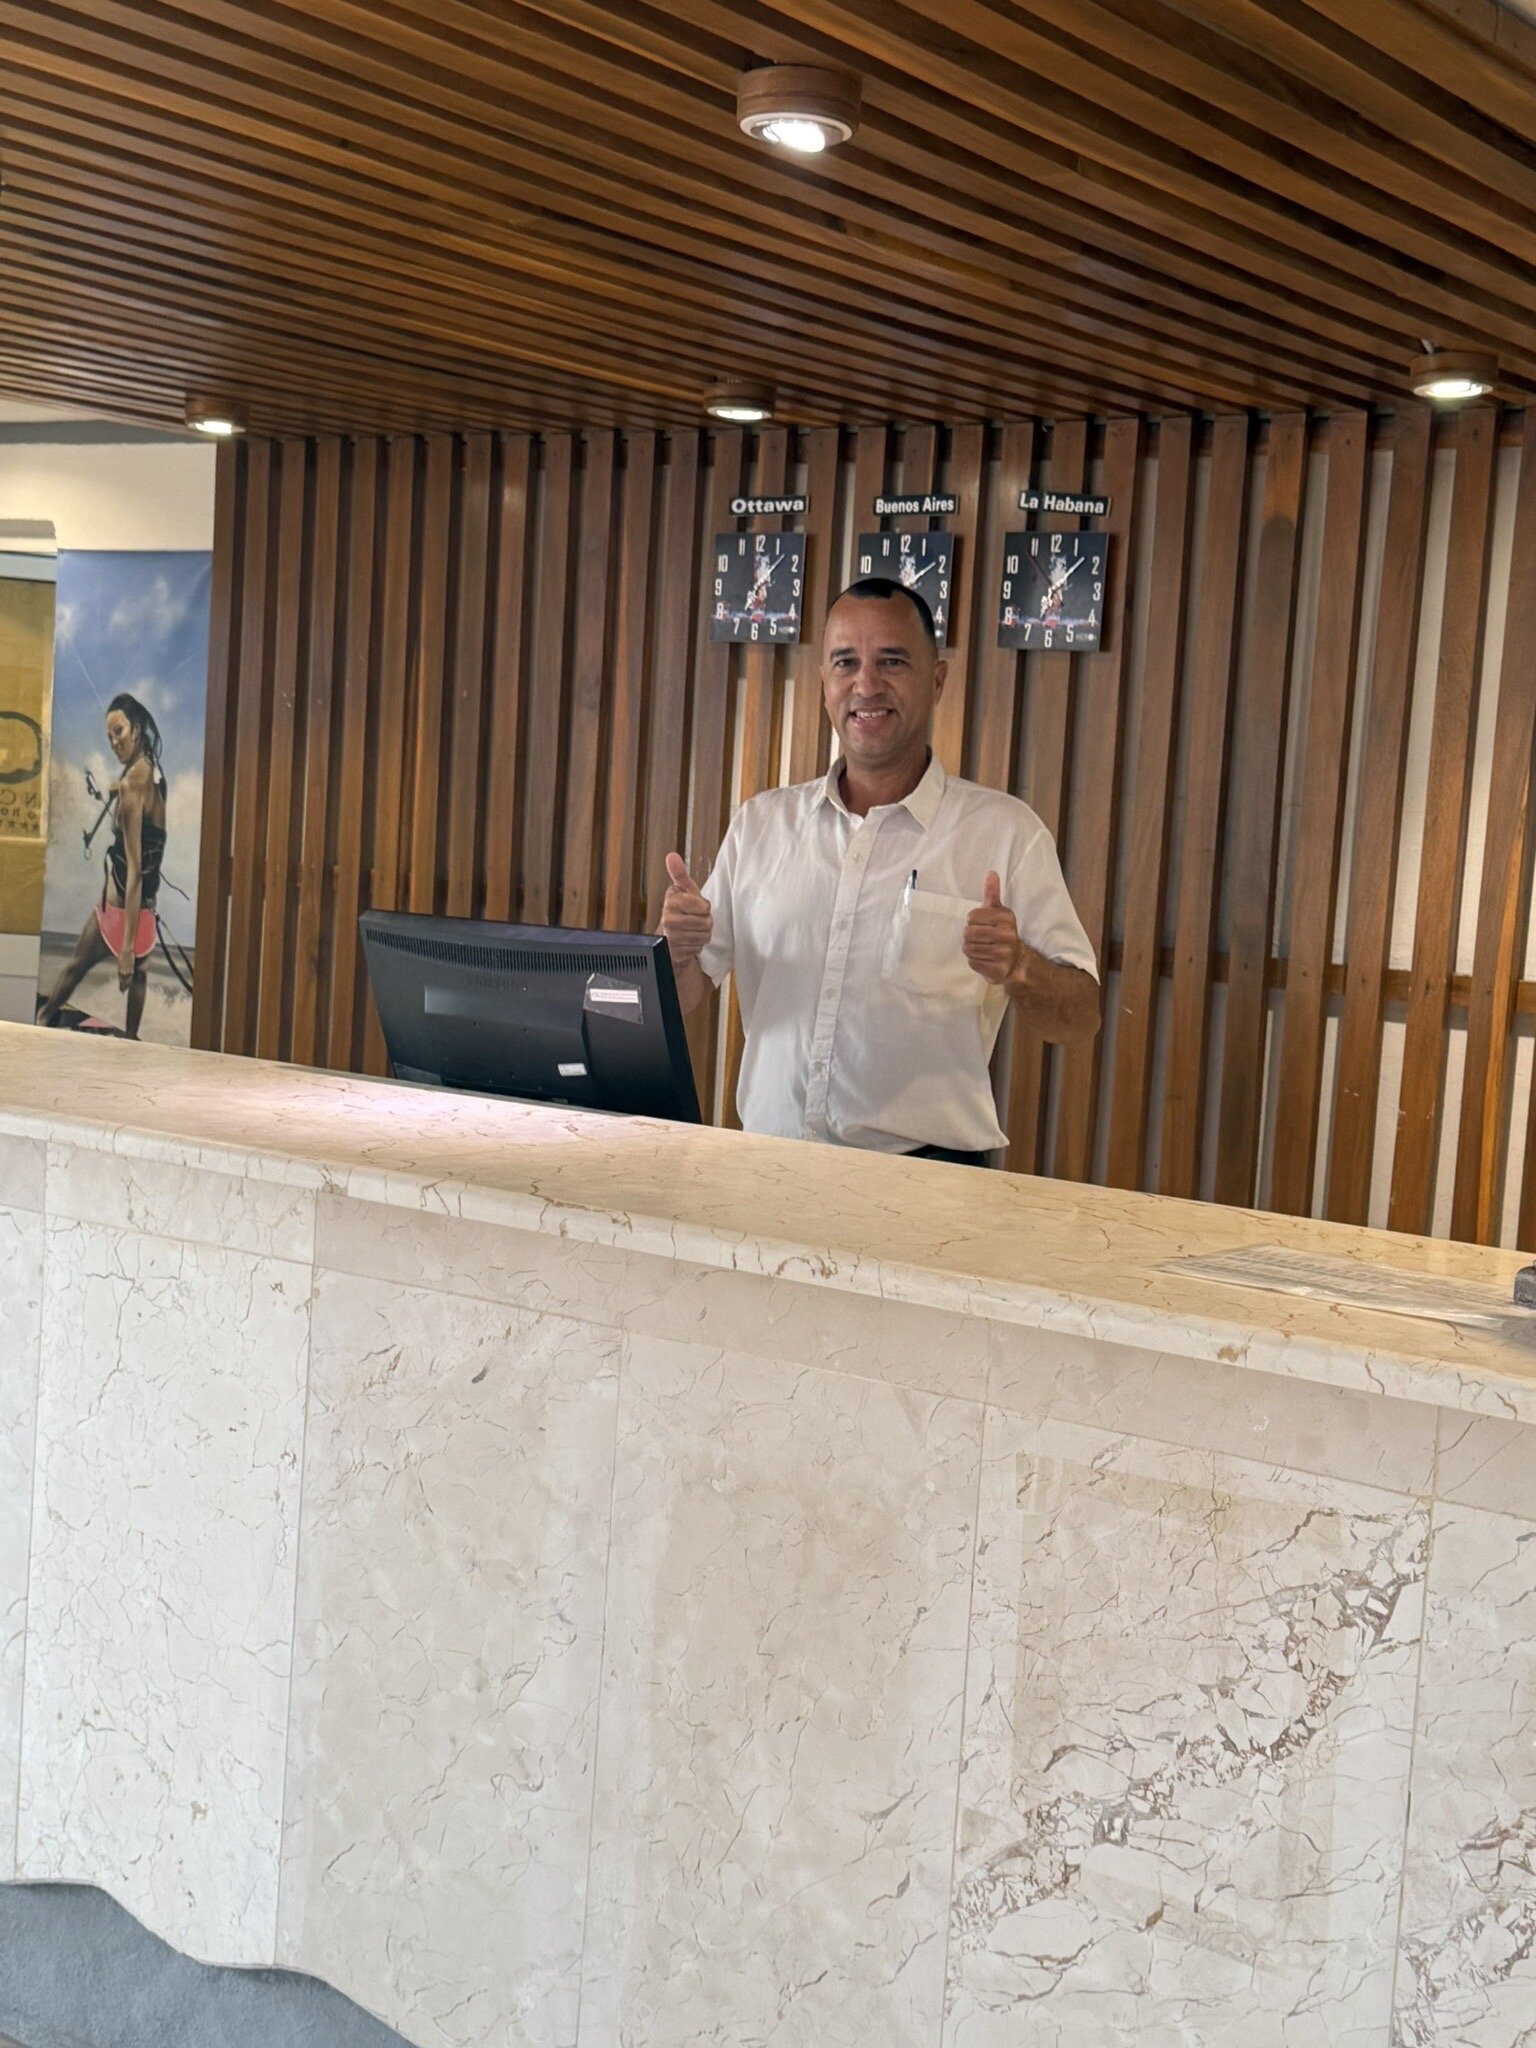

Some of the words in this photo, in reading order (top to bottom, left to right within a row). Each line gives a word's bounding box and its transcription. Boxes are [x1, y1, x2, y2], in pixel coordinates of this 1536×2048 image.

[731, 498, 805, 514] Ottawa
[876, 498, 920, 514] Buenos
[922, 496, 954, 512] Aires
[1020, 492, 1039, 509] La
[1044, 494, 1104, 514] Habana
[739, 538, 746, 556] 11
[756, 535, 766, 552] 12
[776, 538, 781, 556] 1
[882, 538, 890, 556] 11
[900, 534, 911, 553] 12
[922, 538, 927, 556] 1
[1031, 538, 1039, 557] 11
[1051, 535, 1062, 553] 12
[1074, 538, 1079, 557] 1
[718, 555, 729, 572] 10
[791, 554, 799, 573] 2
[860, 556, 872, 574] 10
[938, 555, 946, 574] 2
[1007, 556, 1018, 574] 10
[1092, 556, 1100, 575] 2
[715, 578, 722, 596] 9
[792, 579, 800, 597] 3
[940, 581, 948, 599] 3
[1003, 581, 1011, 600] 9
[1093, 582, 1101, 601] 3
[716, 602, 724, 620] 8
[789, 603, 796, 620] 4
[936, 605, 943, 624] 4
[1004, 606, 1012, 626] 8
[1088, 608, 1096, 627] 4
[733, 618, 740, 635] 7
[751, 623, 758, 640] 6
[770, 619, 777, 635] 5
[1024, 623, 1032, 642] 7
[1066, 624, 1074, 643] 5
[1044, 629, 1053, 648] 6
